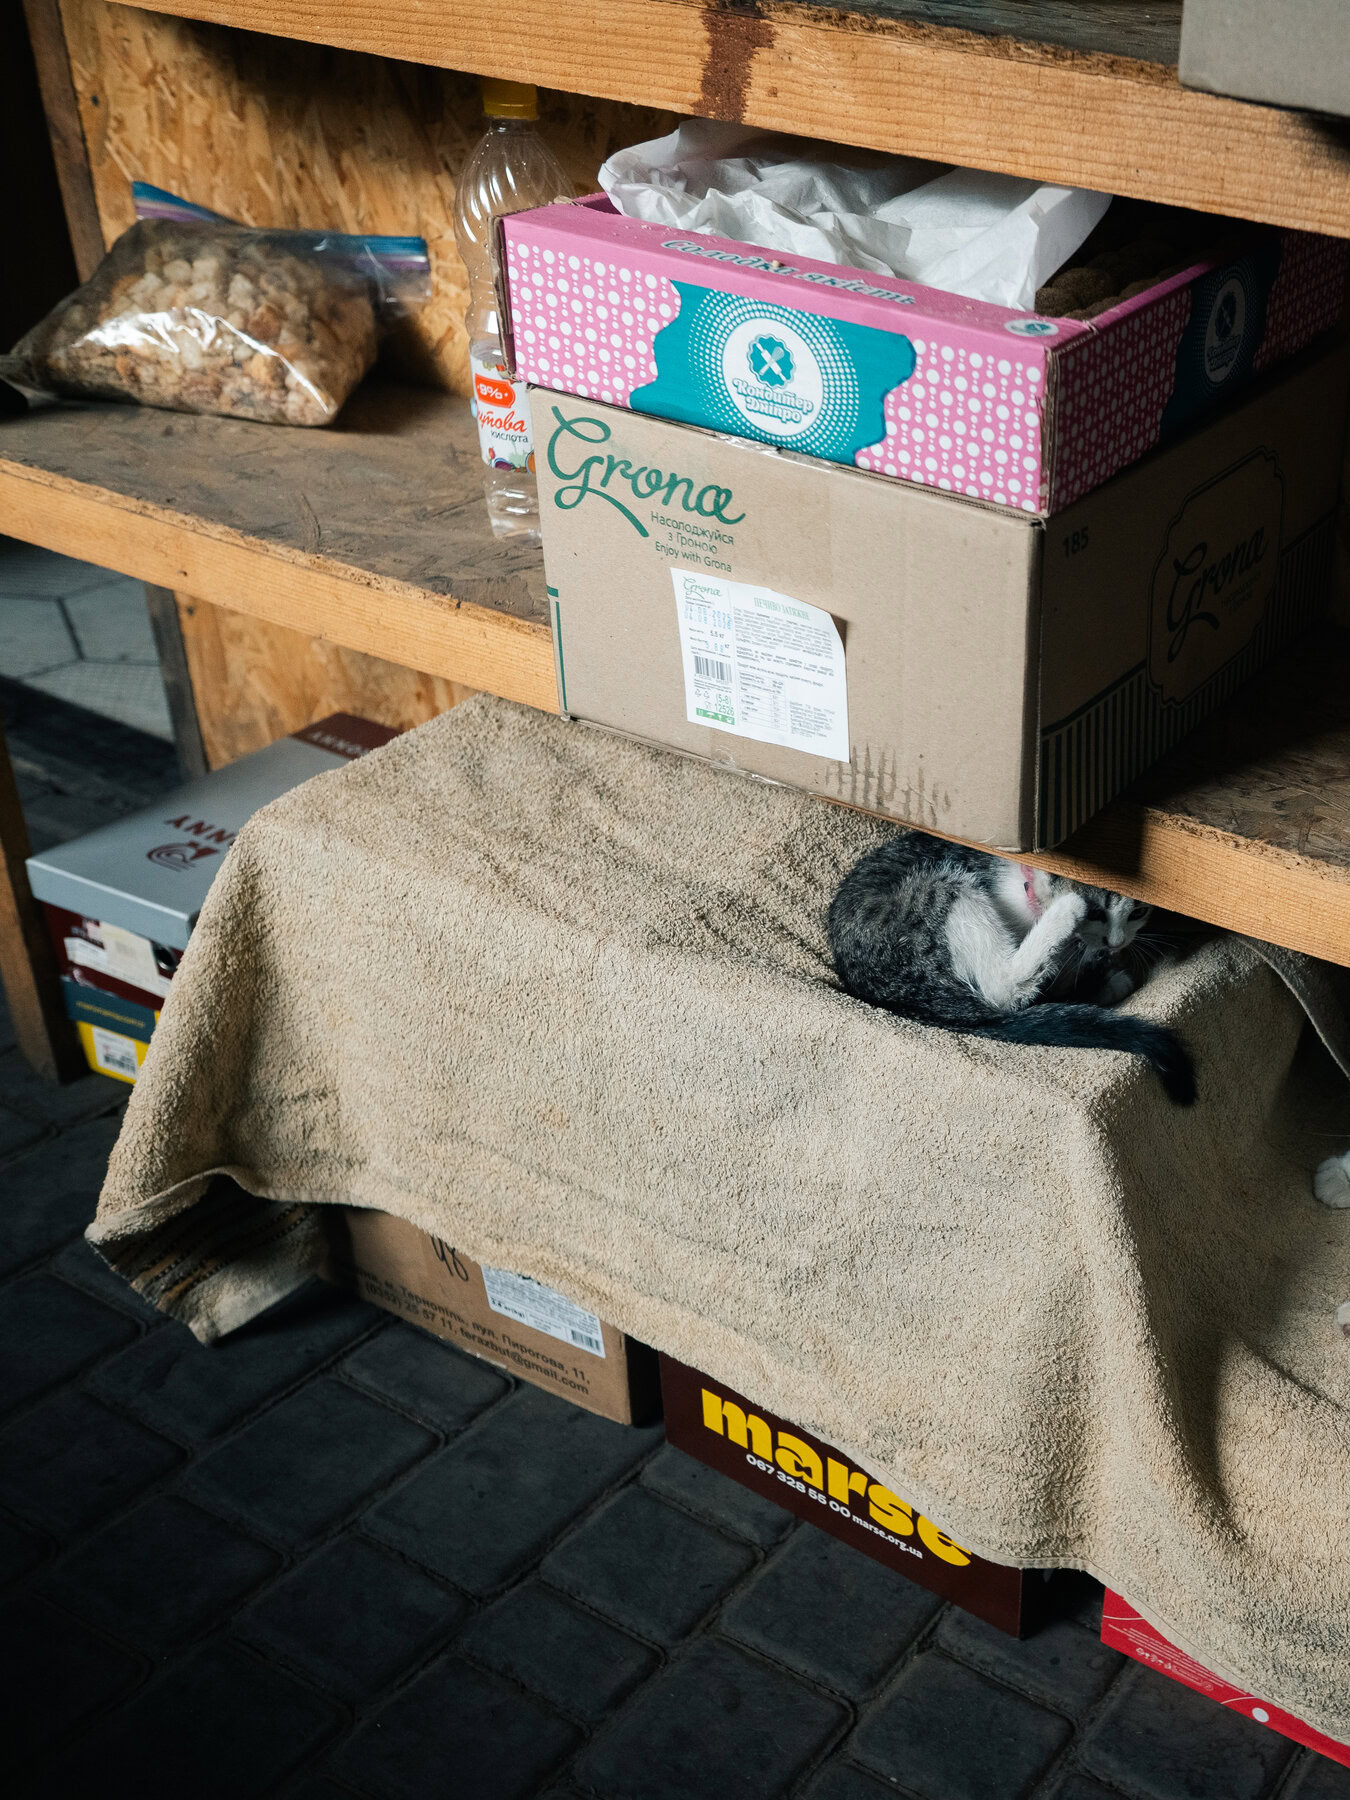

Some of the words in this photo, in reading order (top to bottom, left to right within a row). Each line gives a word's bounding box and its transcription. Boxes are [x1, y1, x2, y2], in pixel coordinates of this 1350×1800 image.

[661, 238, 798, 277] Солодка
[795, 271, 916, 305] якість
[732, 377, 815, 416] Кондитер
[744, 396, 803, 425] Дніпро
[478, 410, 528, 433] цтова
[490, 429, 529, 443] кислота
[547, 405, 746, 538] Grona
[650, 510, 735, 546] Насолоджуйся
[676, 531, 718, 555] Гроною
[1062, 526, 1089, 557] 185
[655, 541, 680, 558] Enjoy
[681, 549, 701, 564] with
[703, 557, 732, 573] Grona
[683, 576, 722, 600] Grona
[701, 1388, 972, 1567] marse
[745, 1453, 776, 1476] 067
[776, 1469, 806, 1495] 328
[807, 1487, 828, 1507] 55
[828, 1499, 851, 1519] 00
[852, 1513, 924, 1560] marse.org.ua
